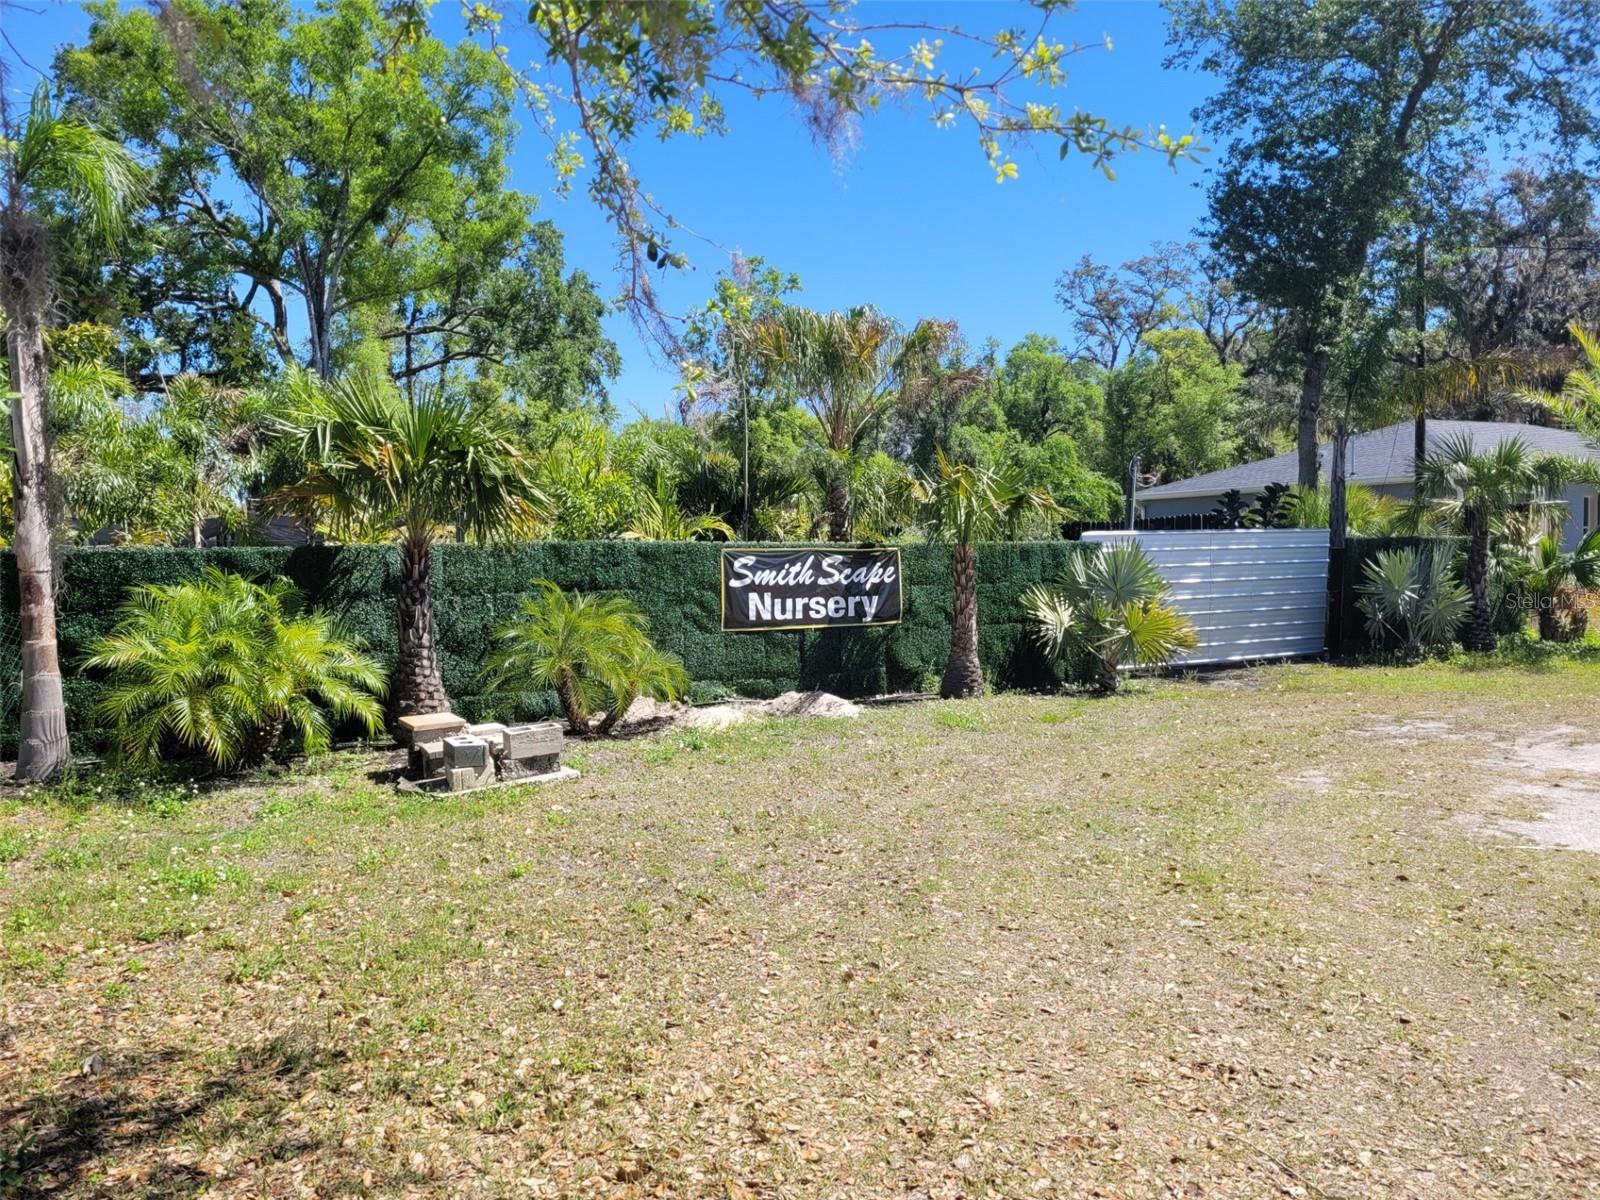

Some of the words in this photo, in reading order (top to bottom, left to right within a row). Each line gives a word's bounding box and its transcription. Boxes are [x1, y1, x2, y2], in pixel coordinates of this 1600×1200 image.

[729, 554, 815, 587] Smith
[818, 555, 896, 591] Scape
[748, 592, 879, 622] Nursery
